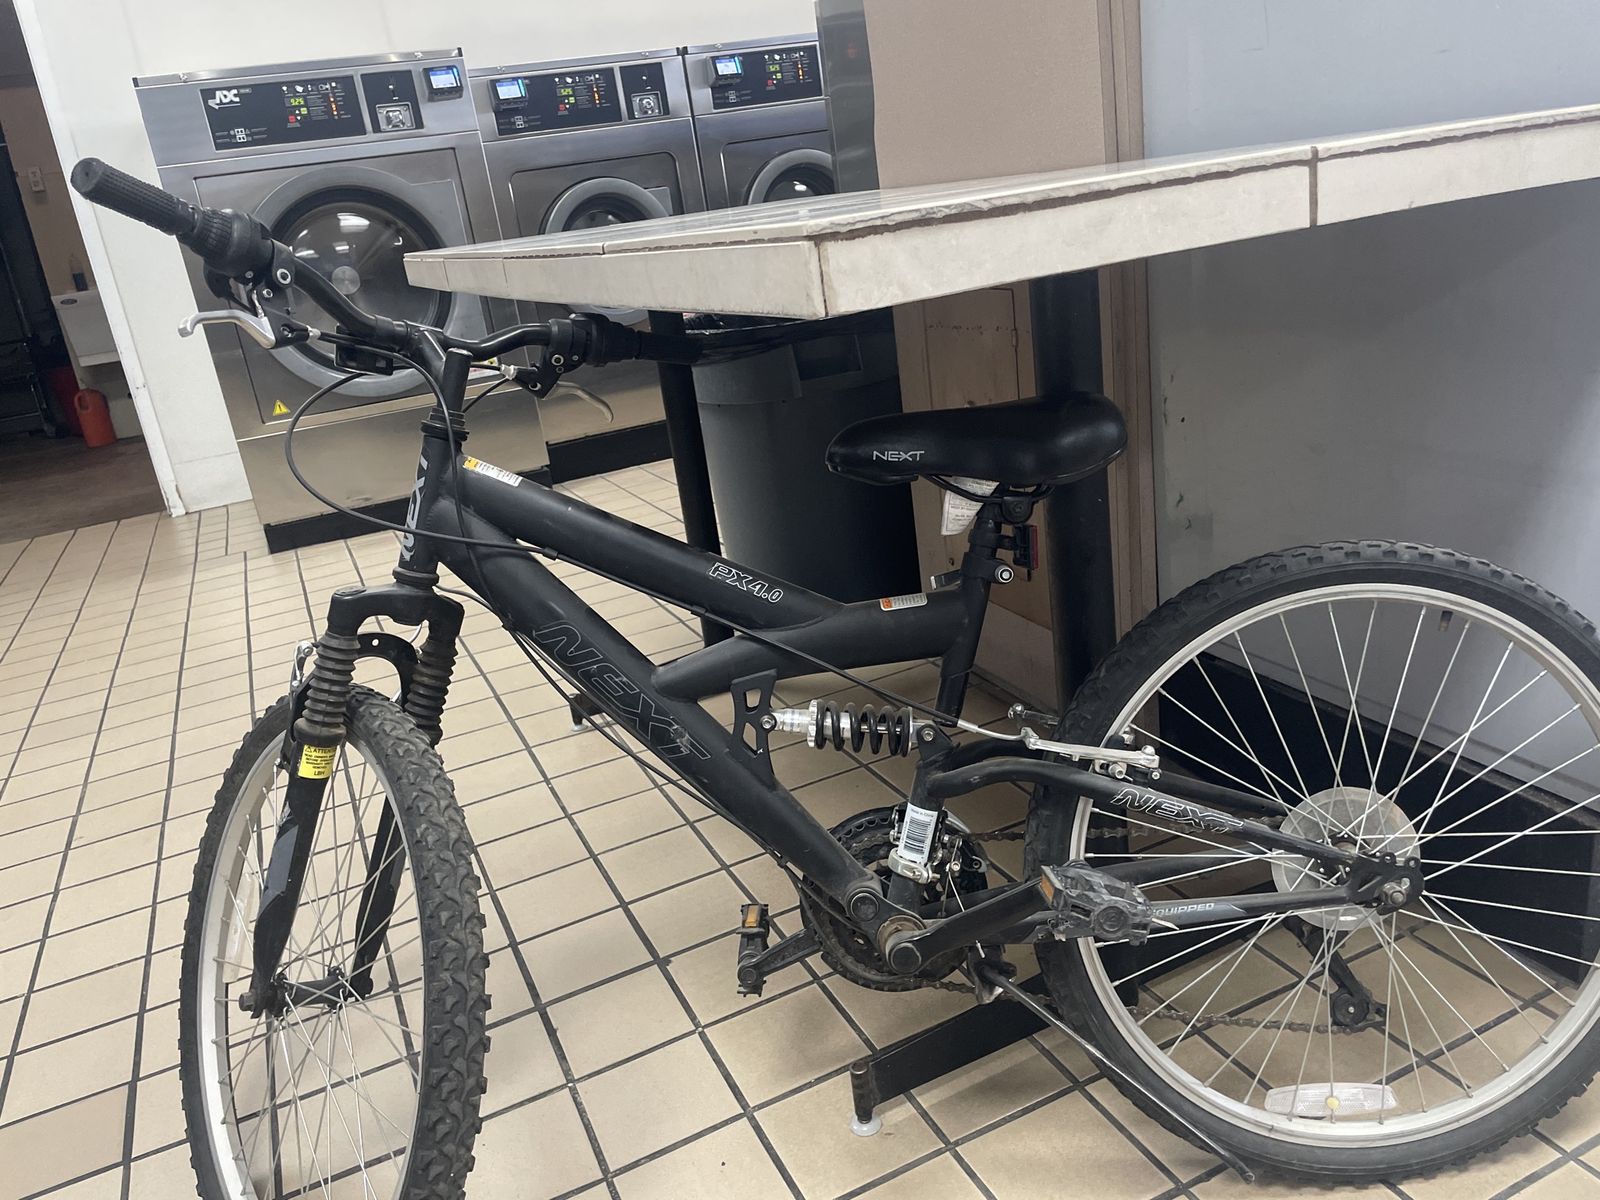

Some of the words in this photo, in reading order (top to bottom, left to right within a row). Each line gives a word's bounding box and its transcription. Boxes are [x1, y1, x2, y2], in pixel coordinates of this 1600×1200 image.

[213, 89, 241, 104] ADC
[872, 450, 925, 462] NEXT
[709, 562, 784, 603] PX4.0
[533, 624, 711, 760] NEXT
[1110, 787, 1244, 834] NEXT
[1153, 902, 1215, 917] QUIPPED
